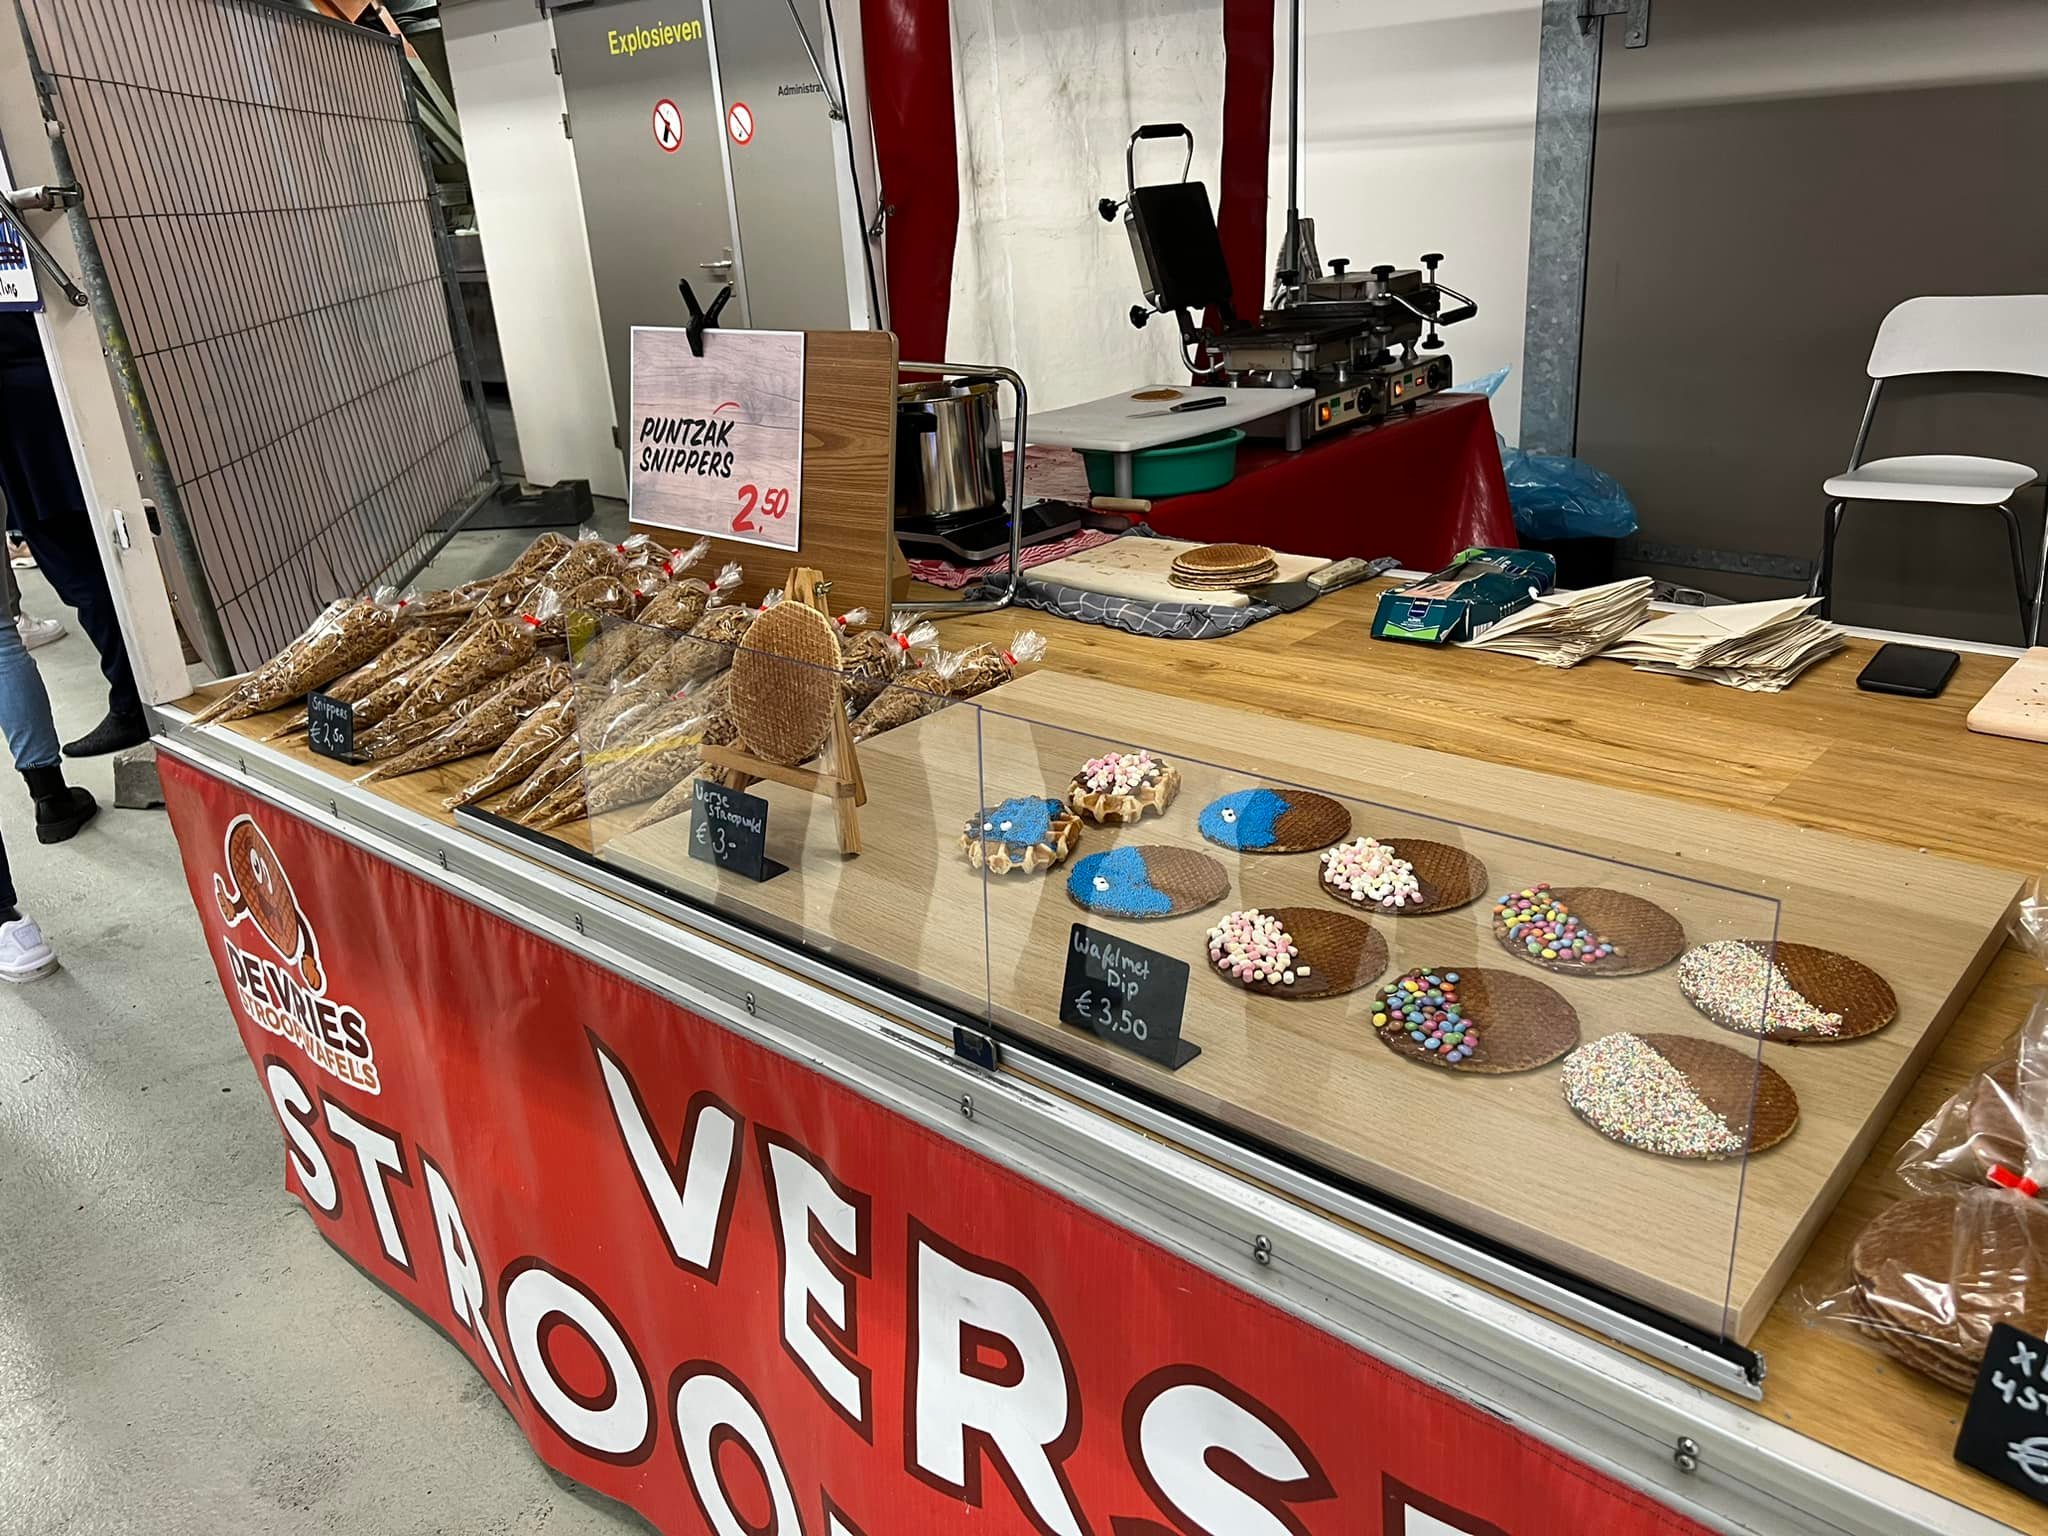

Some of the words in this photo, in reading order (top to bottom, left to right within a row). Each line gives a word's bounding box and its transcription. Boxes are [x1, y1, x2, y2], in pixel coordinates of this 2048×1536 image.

[608, 19, 702, 56] Explosieven
[640, 417, 735, 448] PUNTZAK
[640, 446, 734, 479] SNIPPERS
[310, 721, 321, 743] €
[695, 783, 730, 808] Verse
[695, 821, 708, 845] €
[1106, 968, 1139, 1001] Dip
[1074, 990, 1092, 1018] €
[1098, 997, 1148, 1041] 3,50
[239, 985, 378, 1090] STROOPWAFELS
[263, 1056, 870, 1536] STROO
[2008, 1340, 2048, 1380] X
